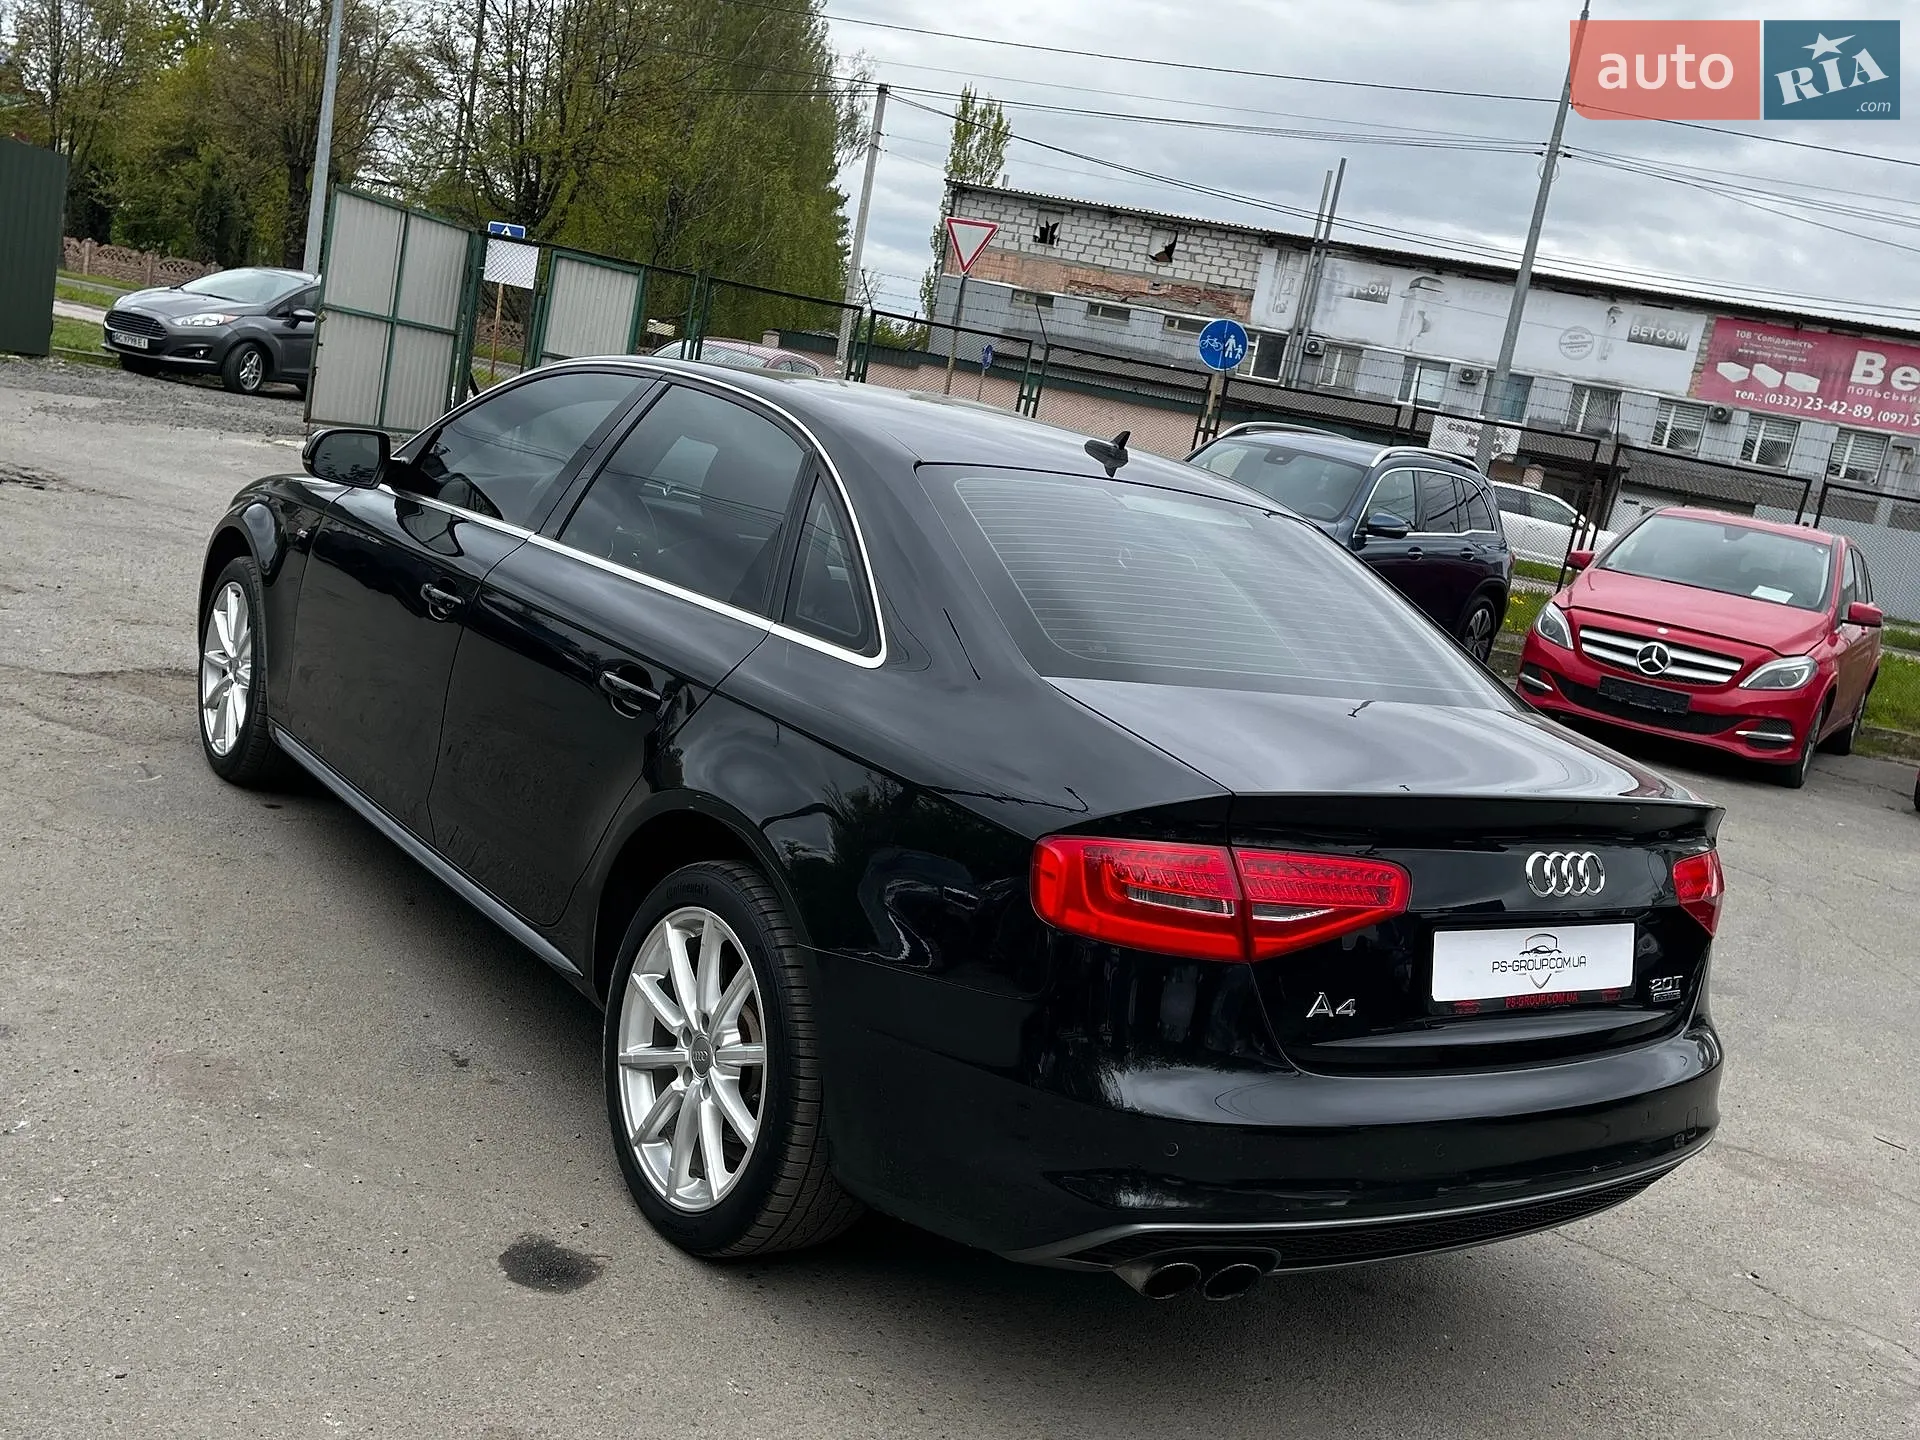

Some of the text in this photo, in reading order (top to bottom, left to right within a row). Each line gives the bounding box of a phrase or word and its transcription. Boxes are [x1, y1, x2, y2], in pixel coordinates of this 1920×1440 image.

[1631, 324, 1690, 344] BETCOM
[1736, 330, 1752, 339] ТОВ
[1847, 385, 1920, 404] польськи
[1764, 393, 1803, 410] (0332)
[1804, 396, 1875, 421] 23-42-89,
[1878, 410, 1909, 427] (097)
[1306, 991, 1357, 1018] A4
